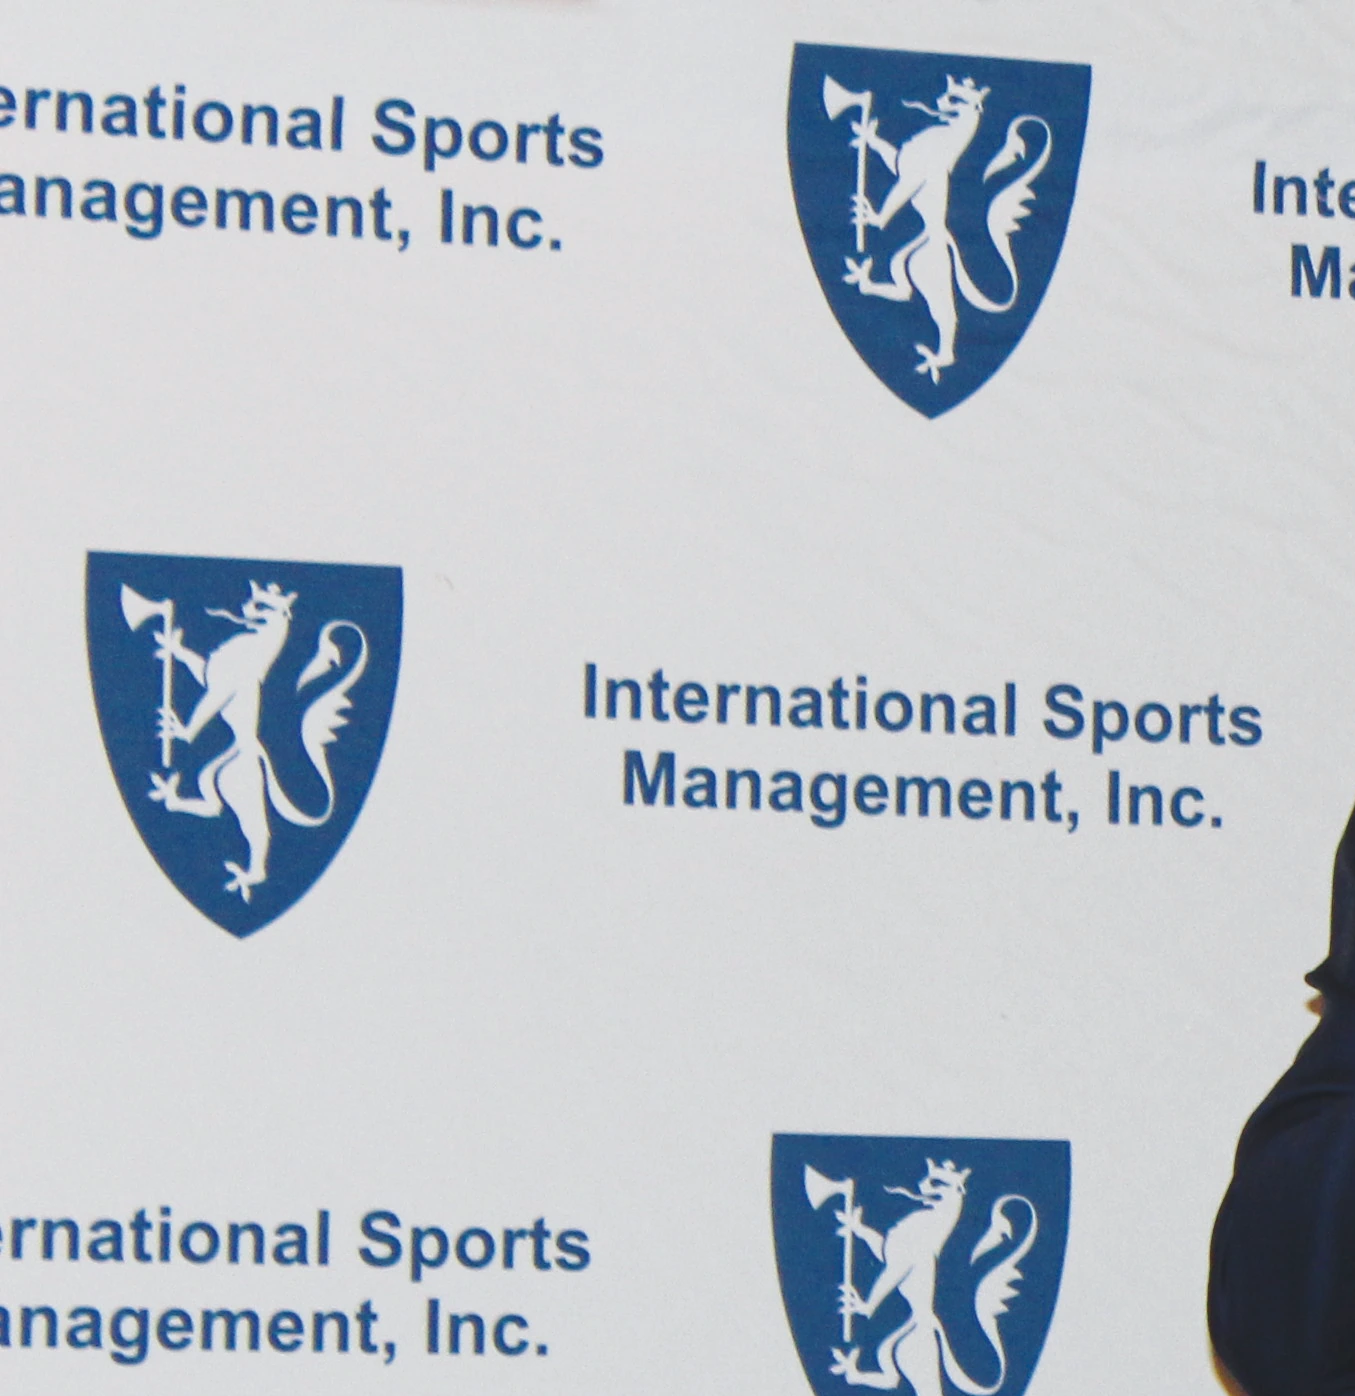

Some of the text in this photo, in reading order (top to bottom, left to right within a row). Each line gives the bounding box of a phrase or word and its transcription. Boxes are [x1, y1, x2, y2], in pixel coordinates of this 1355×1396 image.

[0, 84, 604, 172] rnational Sports
[0, 173, 562, 252] anagement, Inc.
[585, 662, 1263, 755] International Sports
[623, 749, 1223, 834] Management, Inc.
[0, 1205, 591, 1283] rnational Sports
[0, 1298, 548, 1366] nagement, Inc.
